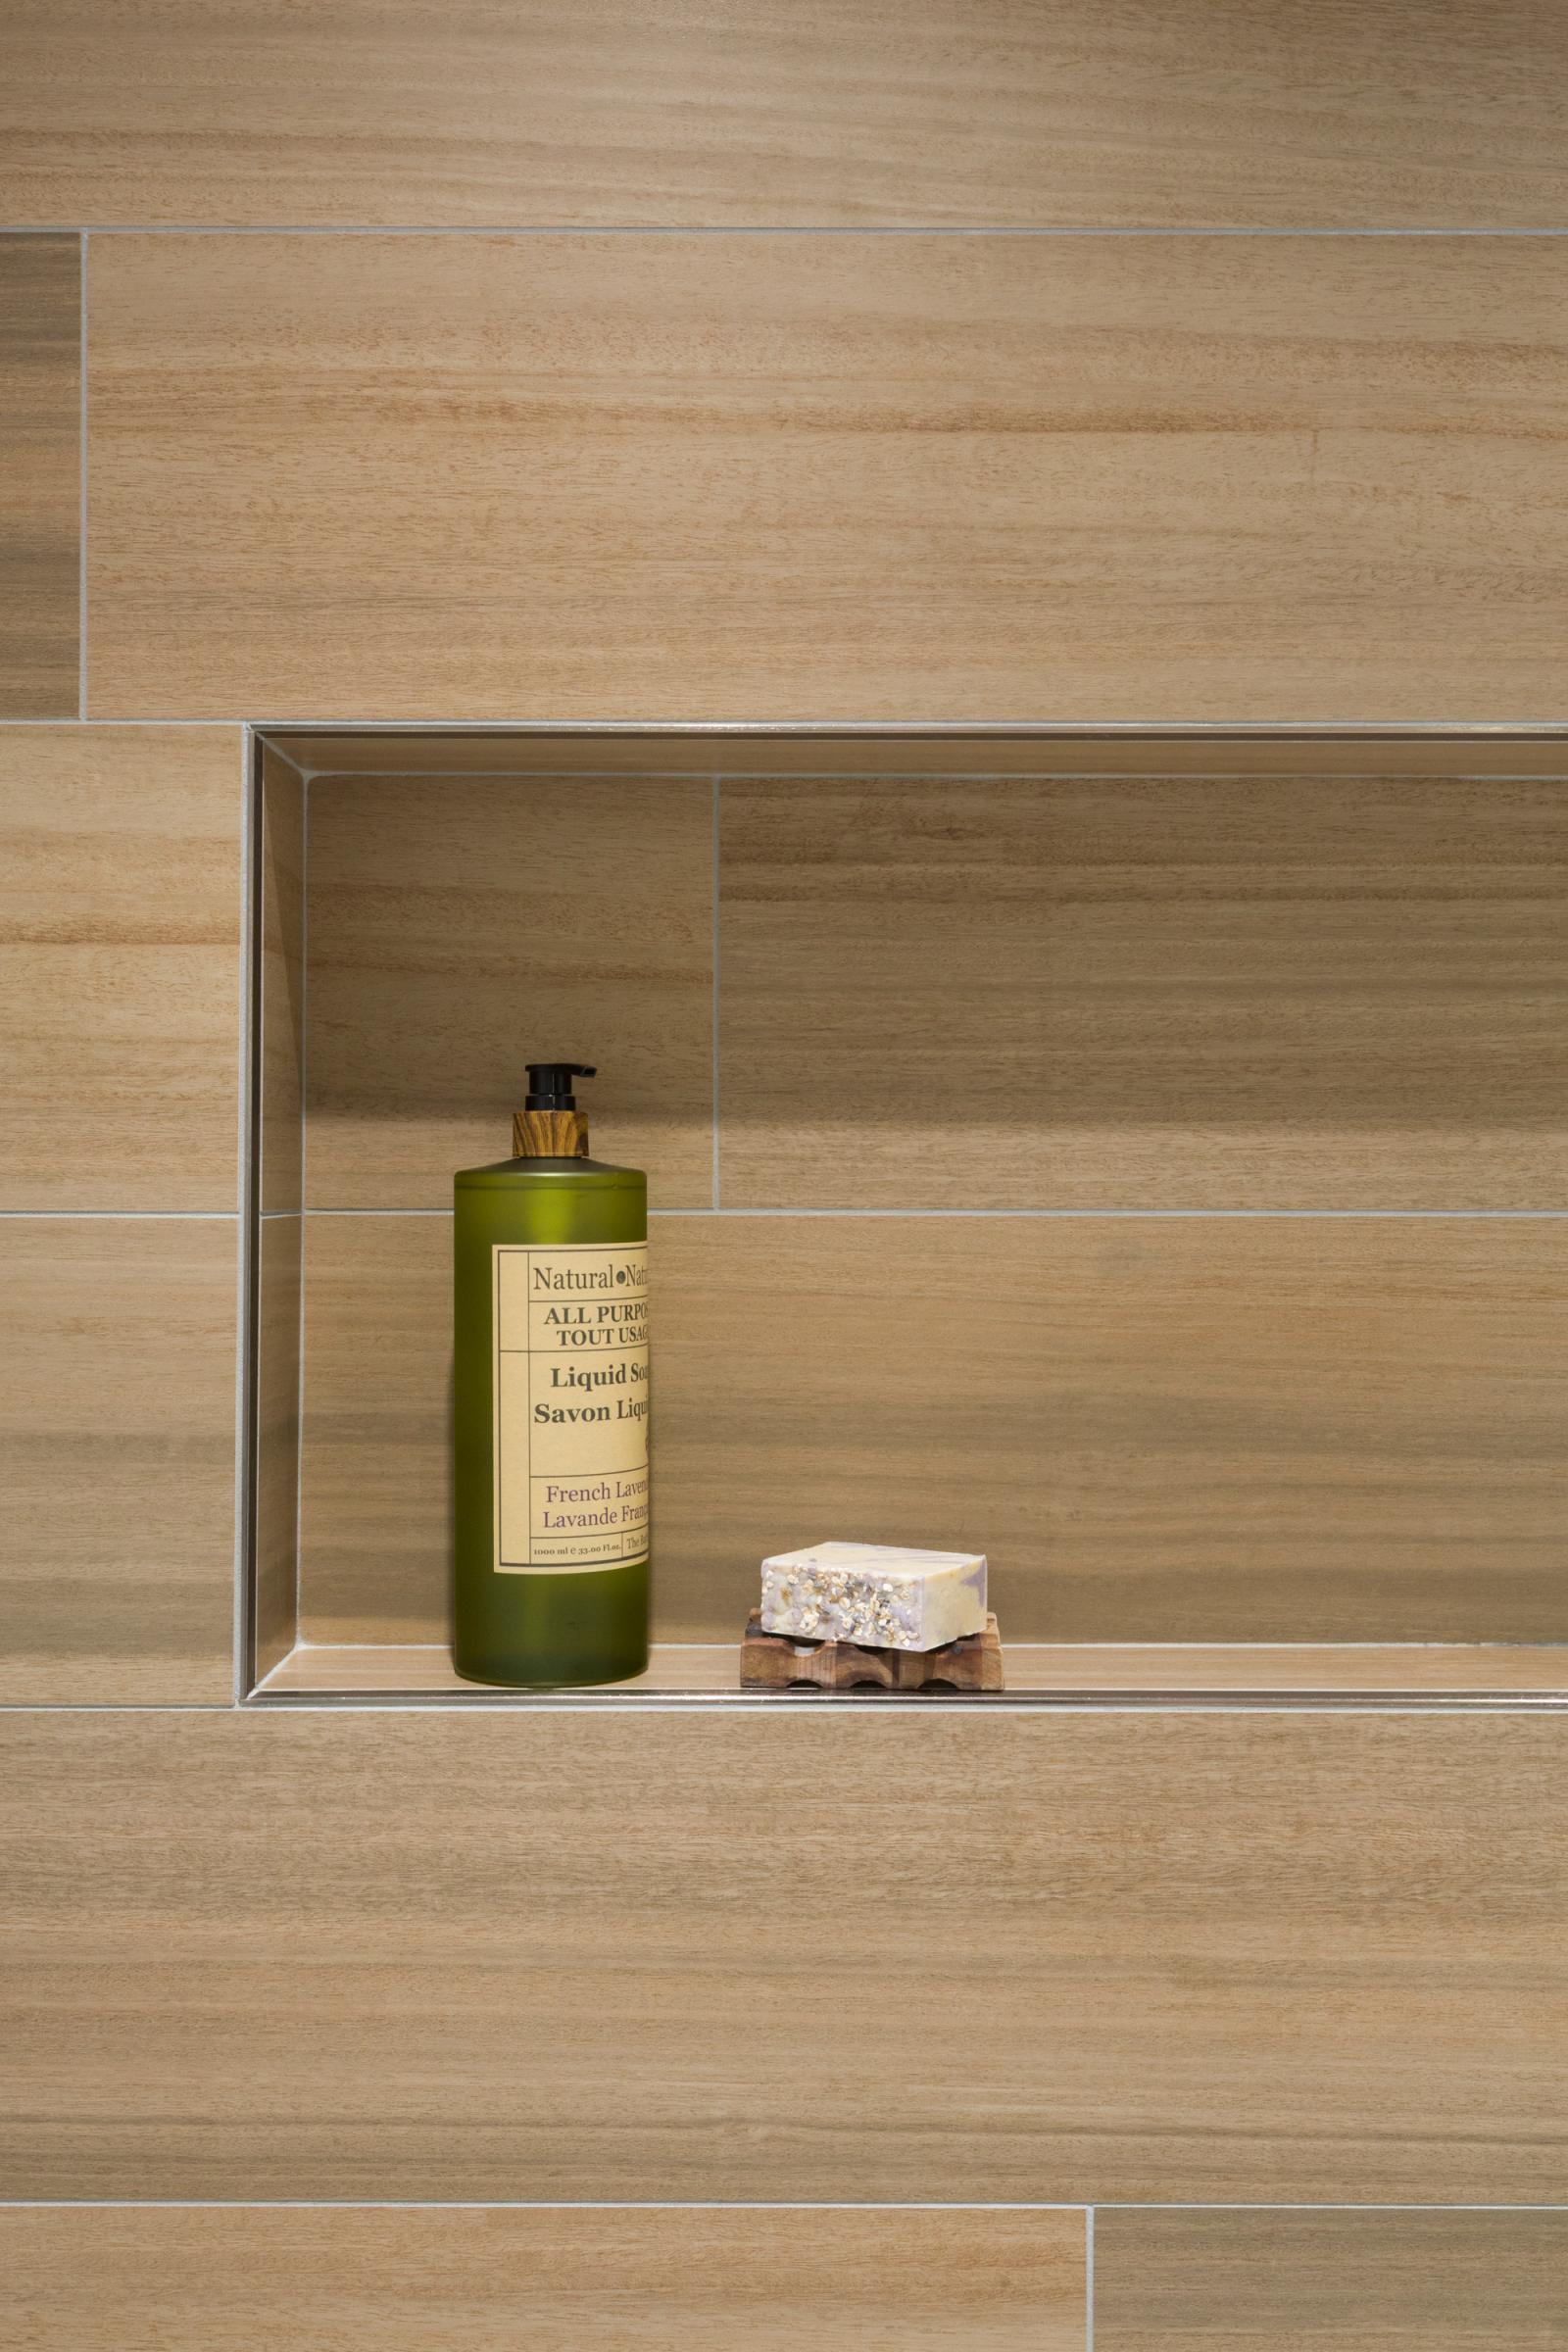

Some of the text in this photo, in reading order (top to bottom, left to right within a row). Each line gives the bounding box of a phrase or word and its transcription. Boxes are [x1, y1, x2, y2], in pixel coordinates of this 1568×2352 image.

[533, 1264, 614, 1291] Natural
[544, 1306, 591, 1325] ALL
[557, 1329, 614, 1347] TOUT
[550, 1363, 627, 1393] Liquid
[534, 1403, 611, 1424] Savon
[546, 1482, 611, 1503] French
[543, 1507, 617, 1529] Lavande
[557, 1546, 568, 1555] ml
[578, 1545, 602, 1556] 33.00
[626, 1538, 641, 1550] The
